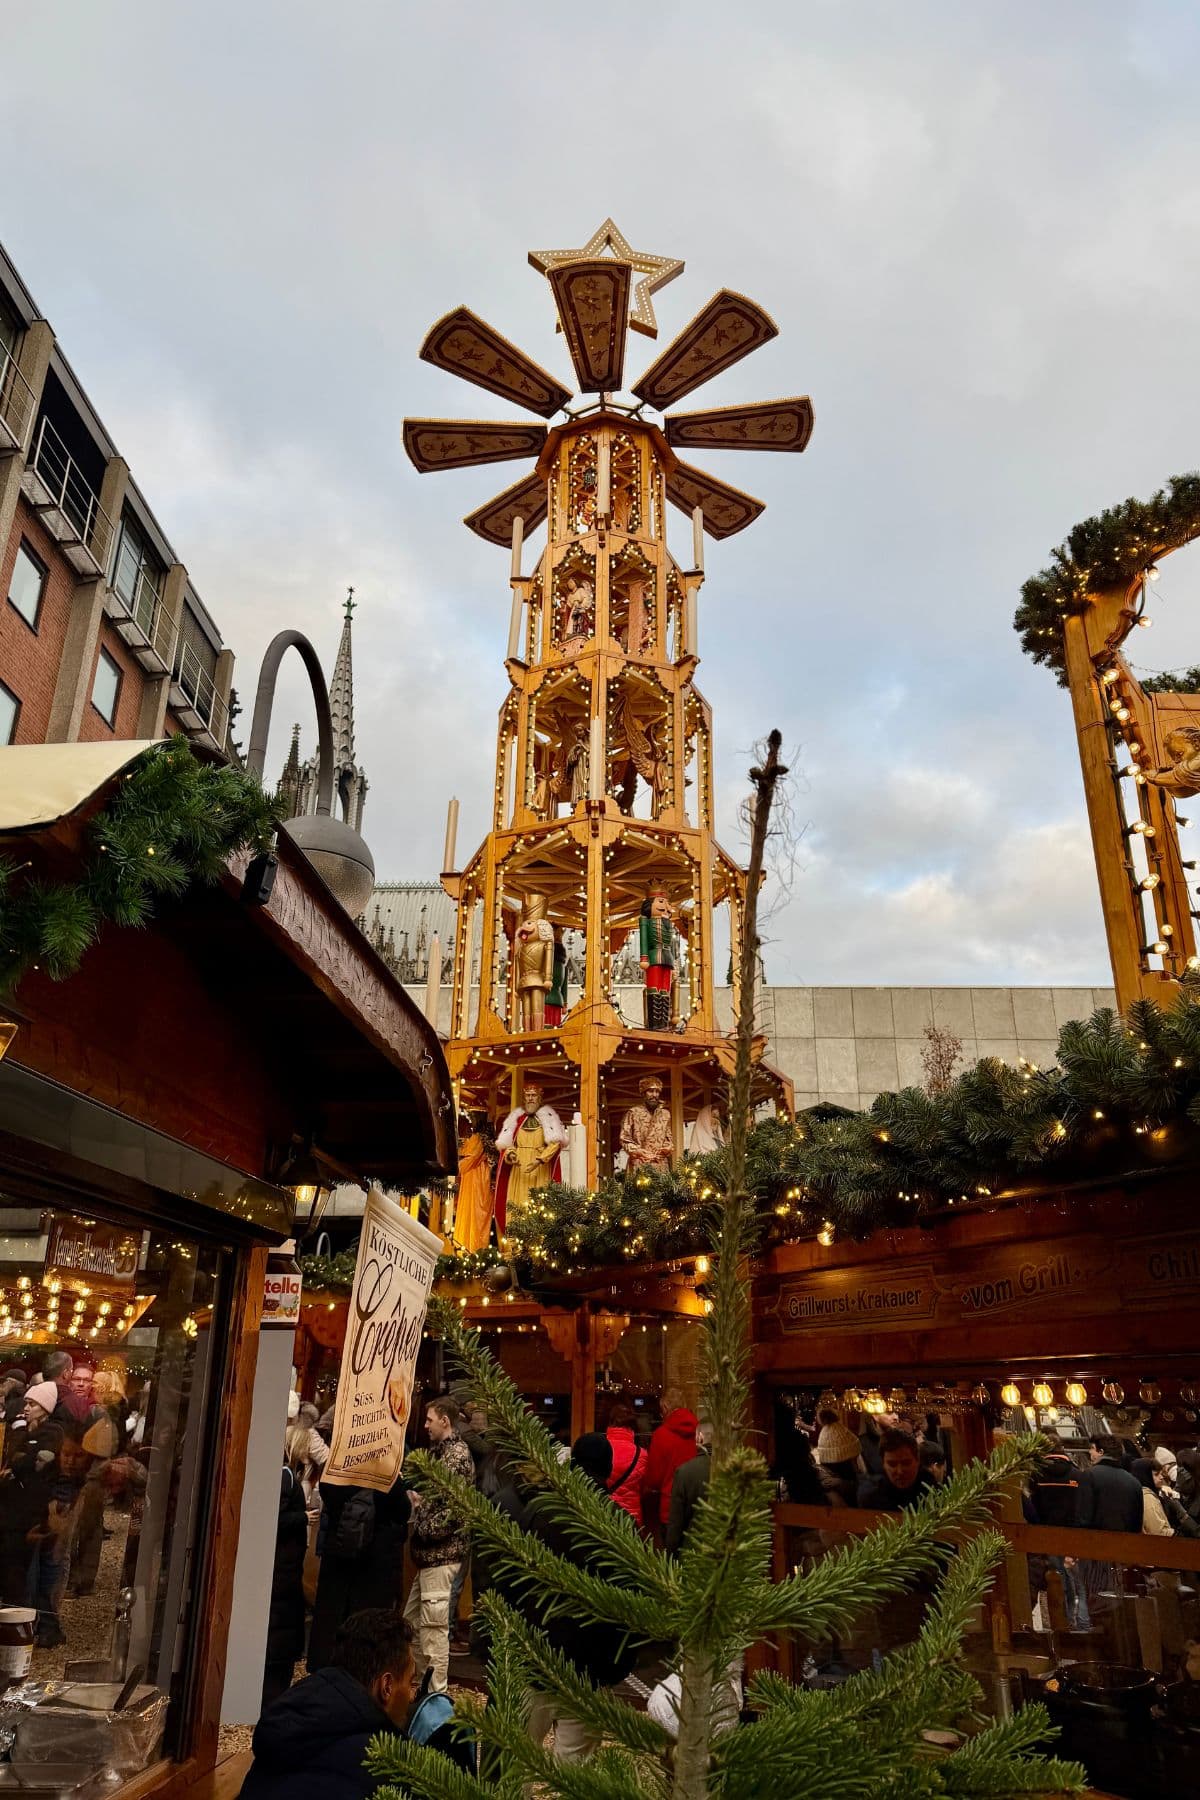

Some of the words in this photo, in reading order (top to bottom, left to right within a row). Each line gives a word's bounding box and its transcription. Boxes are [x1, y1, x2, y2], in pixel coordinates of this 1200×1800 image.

[369, 1226, 428, 1286] KÖSTLICHE
[970, 1277, 1016, 1309] vom
[1018, 1254, 1072, 1294] Grill
[352, 1258, 424, 1402] Crêpes
[347, 1427, 389, 1449] HERZHAFT,
